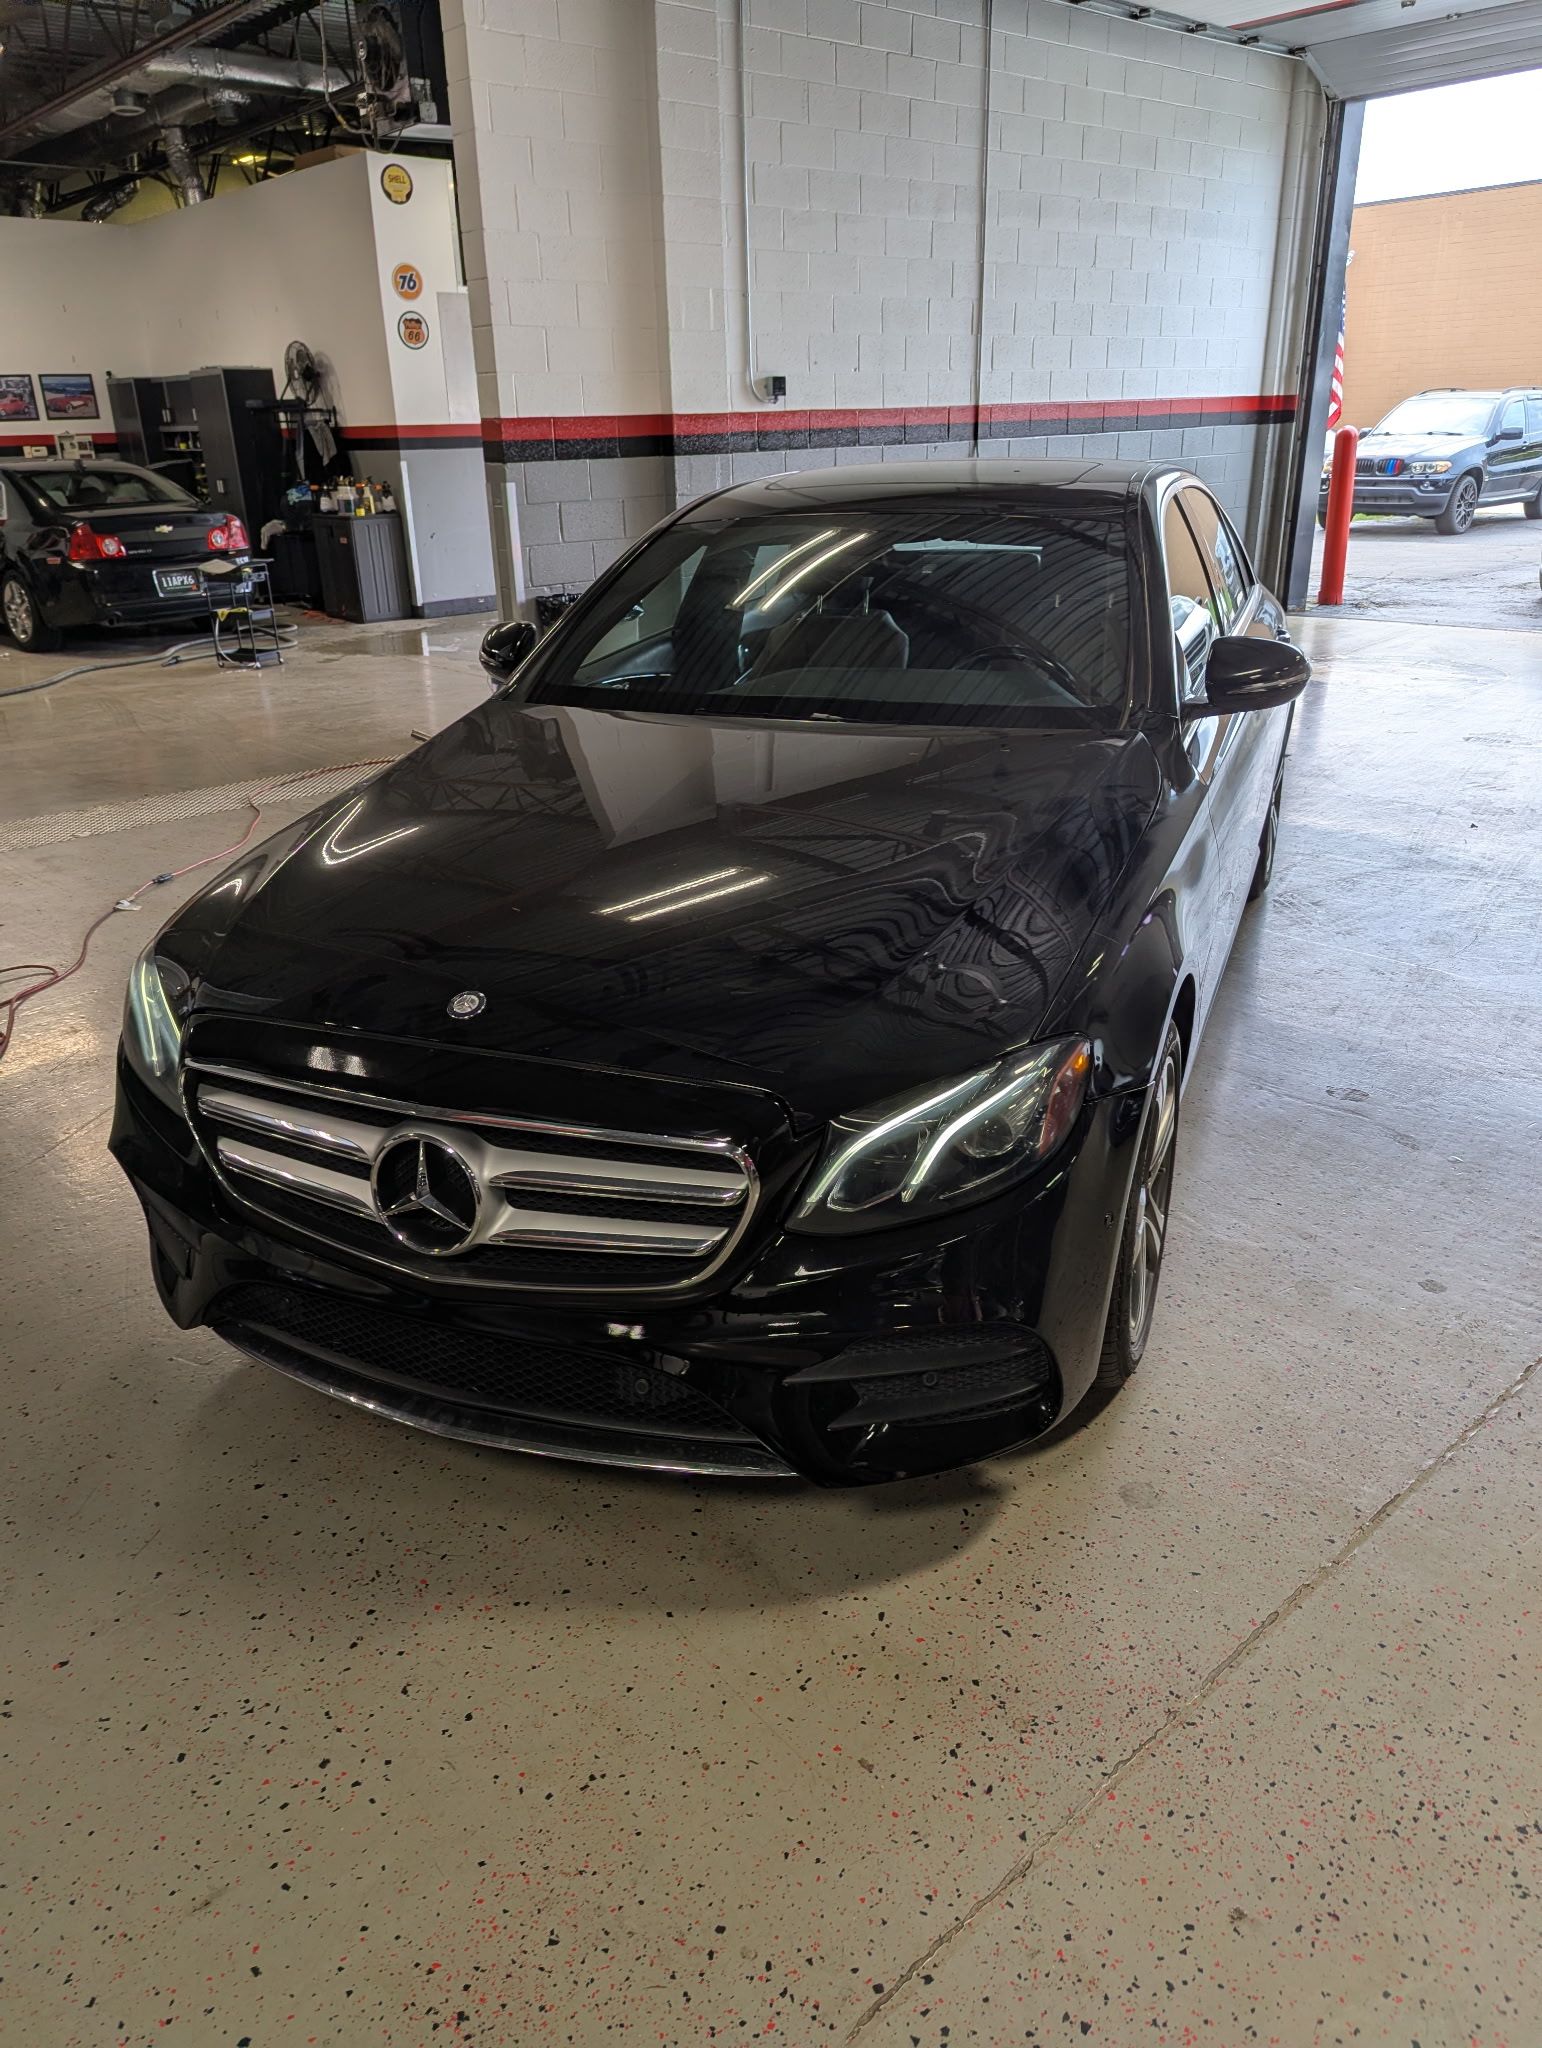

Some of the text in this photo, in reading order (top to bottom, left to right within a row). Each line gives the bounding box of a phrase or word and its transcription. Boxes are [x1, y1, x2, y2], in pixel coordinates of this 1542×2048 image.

[388, 174, 407, 184] SHELL
[399, 273, 417, 291] 76
[408, 330, 421, 342] 66
